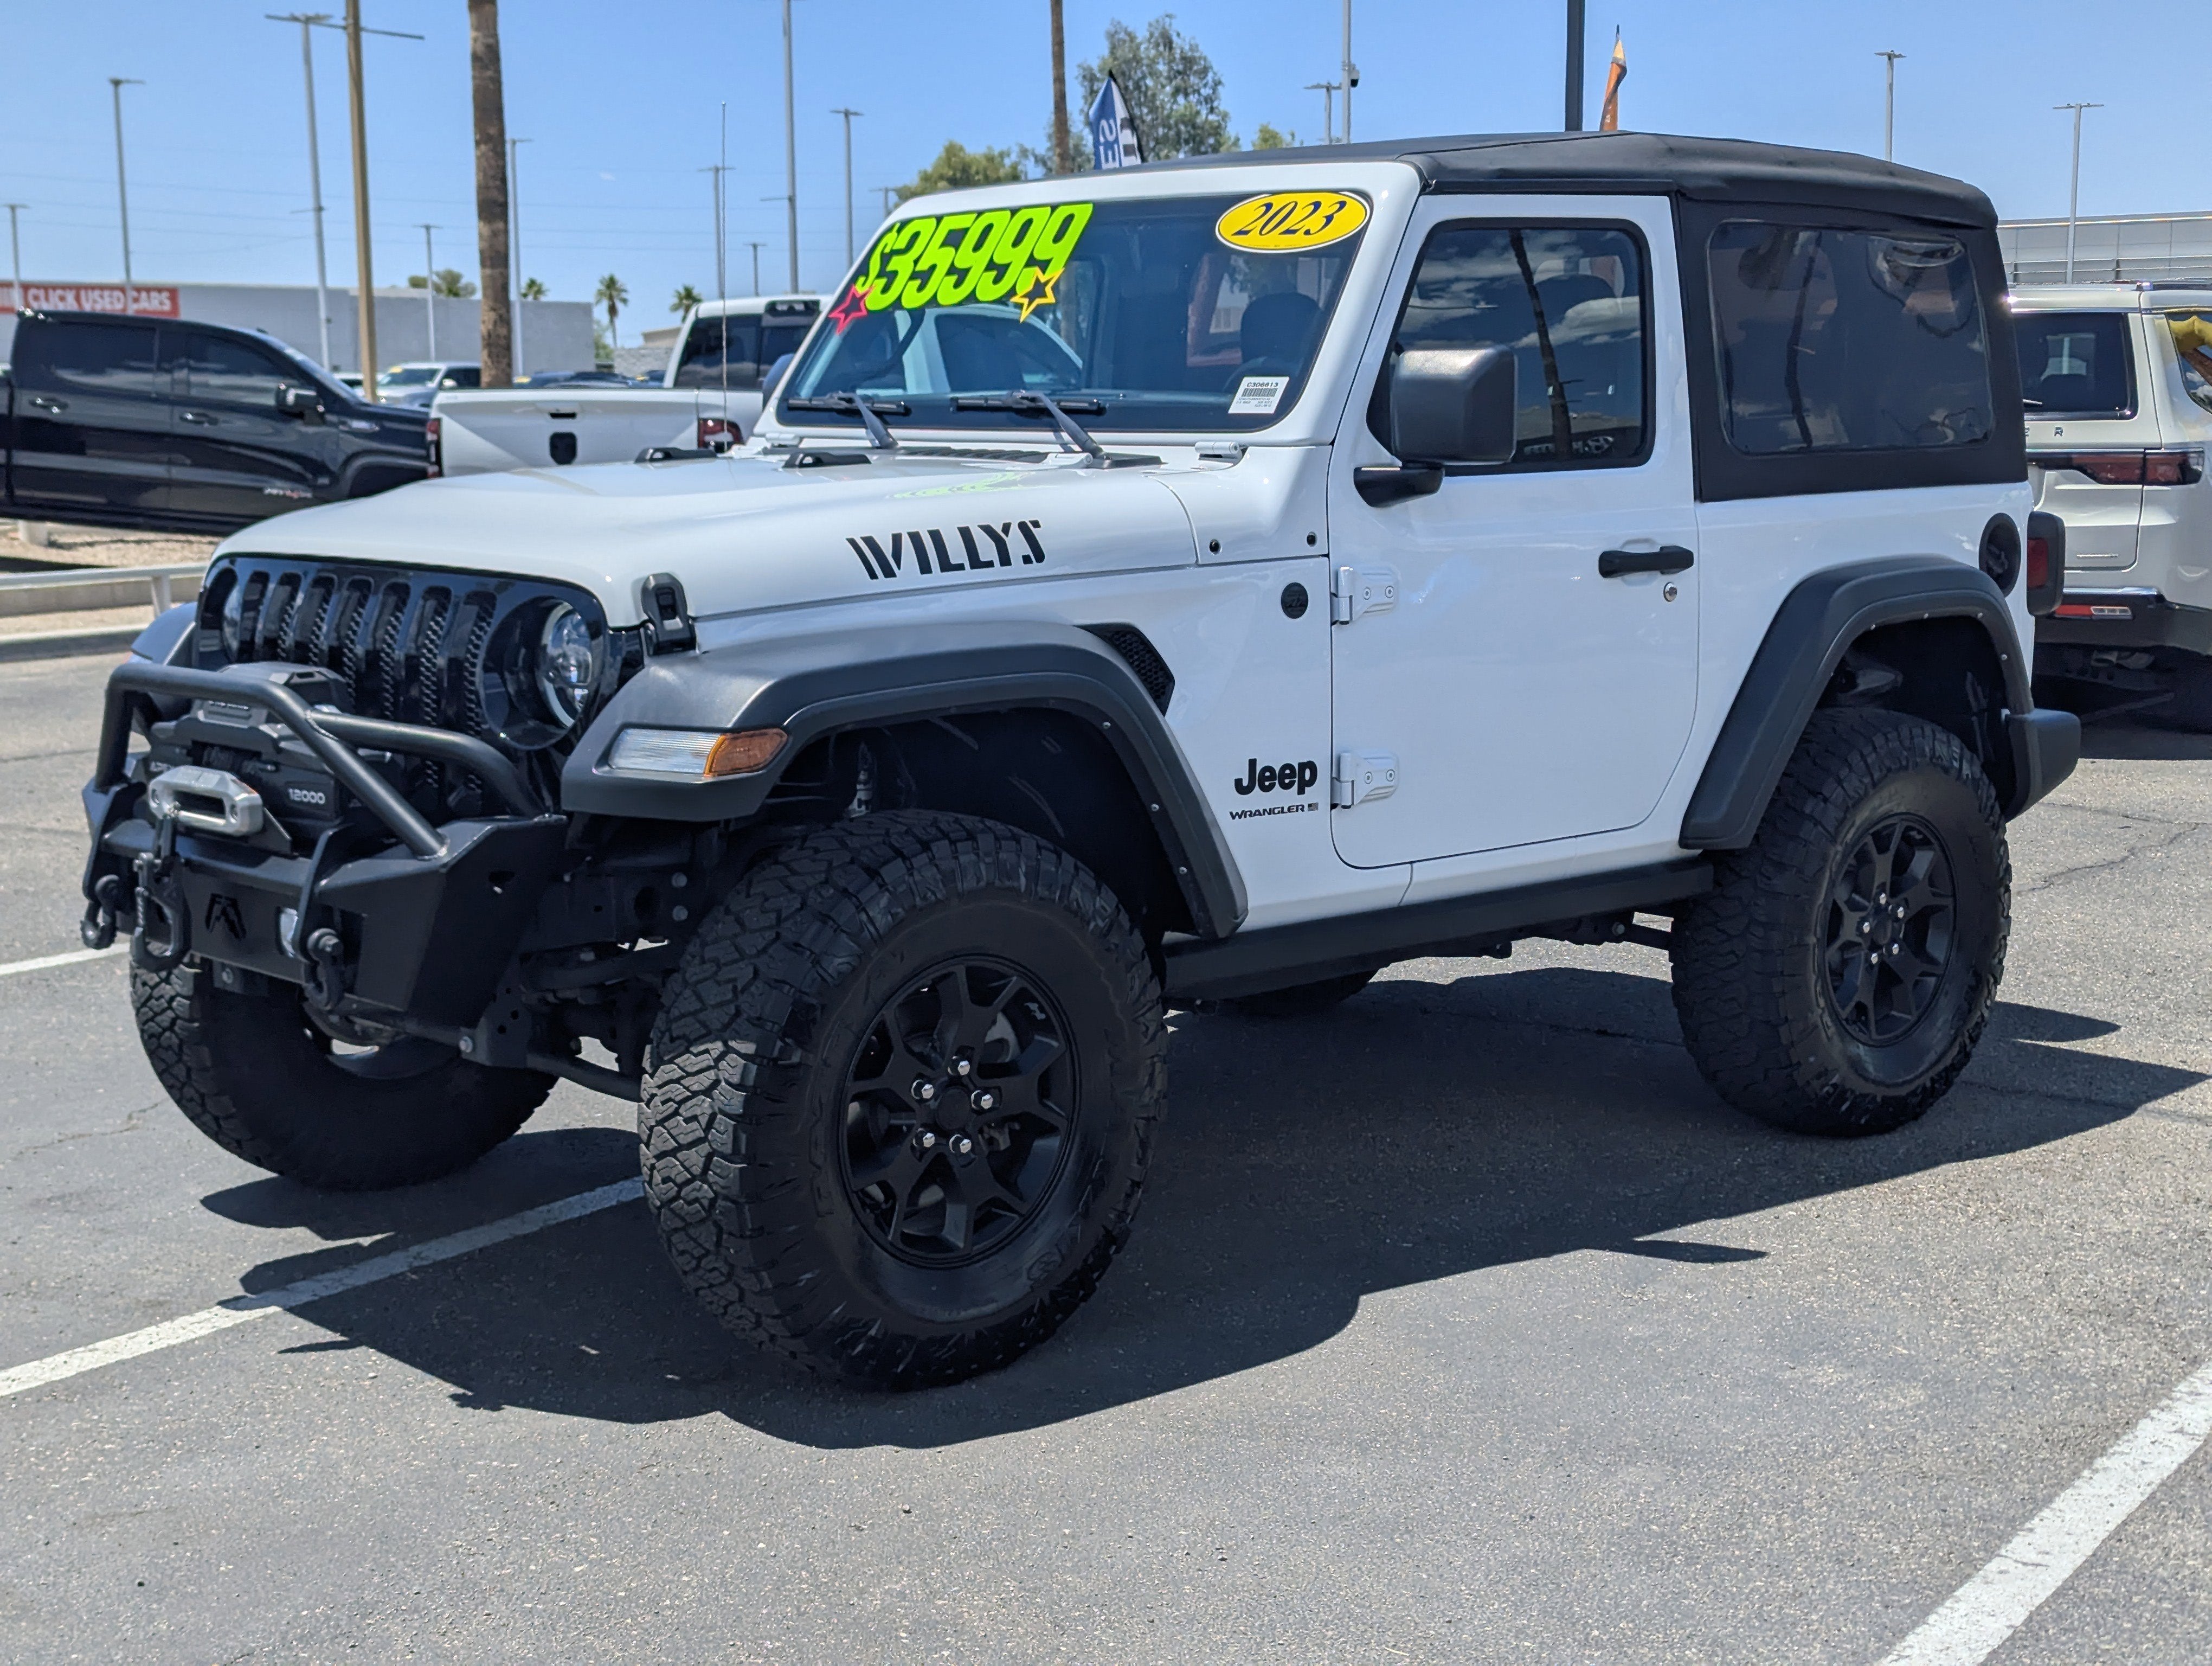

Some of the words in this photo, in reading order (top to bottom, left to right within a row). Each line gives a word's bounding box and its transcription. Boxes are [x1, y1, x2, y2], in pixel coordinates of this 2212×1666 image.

[1231, 200, 1347, 236] 2023
[855, 203, 1094, 311] $35999
[28, 287, 80, 311] CLICK
[81, 287, 125, 312] USED
[129, 290, 171, 312] CARS
[845, 520, 1045, 580] WILLYS
[1234, 758, 1318, 796] Jeep
[288, 788, 325, 804] 12000
[1229, 804, 1305, 820] WRANGLER
